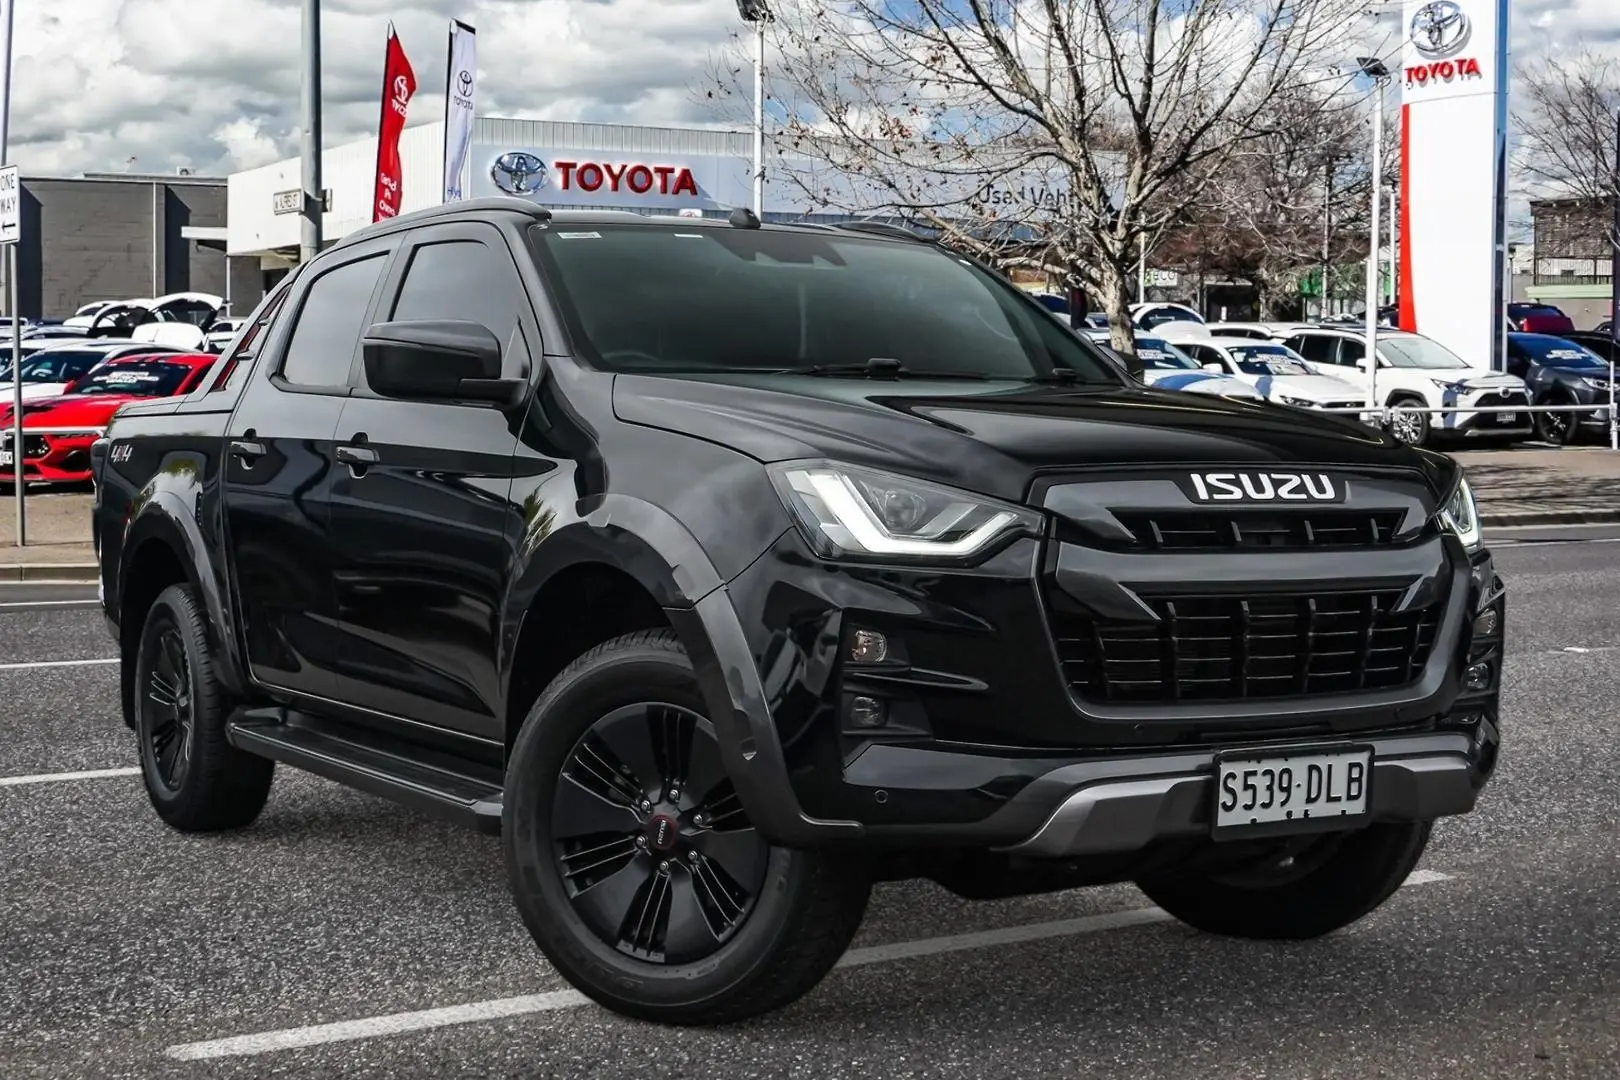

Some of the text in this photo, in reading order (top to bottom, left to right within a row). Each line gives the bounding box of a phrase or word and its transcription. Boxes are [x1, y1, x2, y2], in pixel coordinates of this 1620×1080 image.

[1404, 58, 1481, 83] TOYOTA
[1, 173, 15, 191] ONE
[555, 161, 698, 196] TOYOTA
[1, 197, 16, 213] WAY
[978, 184, 1025, 205] Used
[1190, 473, 1336, 500] ISUZU
